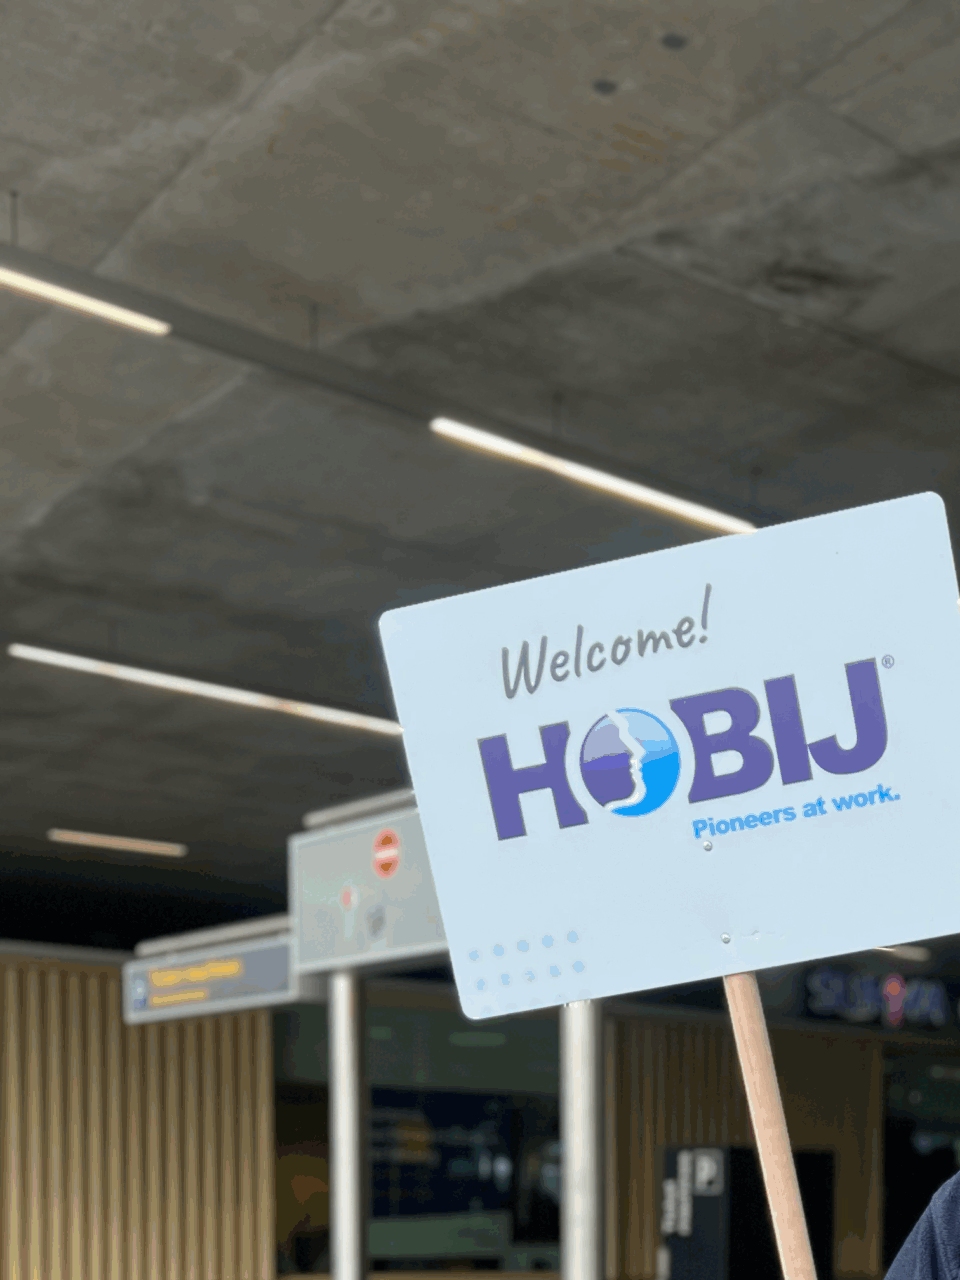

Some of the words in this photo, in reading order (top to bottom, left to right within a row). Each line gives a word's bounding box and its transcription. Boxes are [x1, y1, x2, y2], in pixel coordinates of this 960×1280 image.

[501, 582, 712, 700] Welcome!
[691, 804, 797, 839] Pioneers
[802, 796, 828, 818] at
[831, 783, 901, 811] work.
